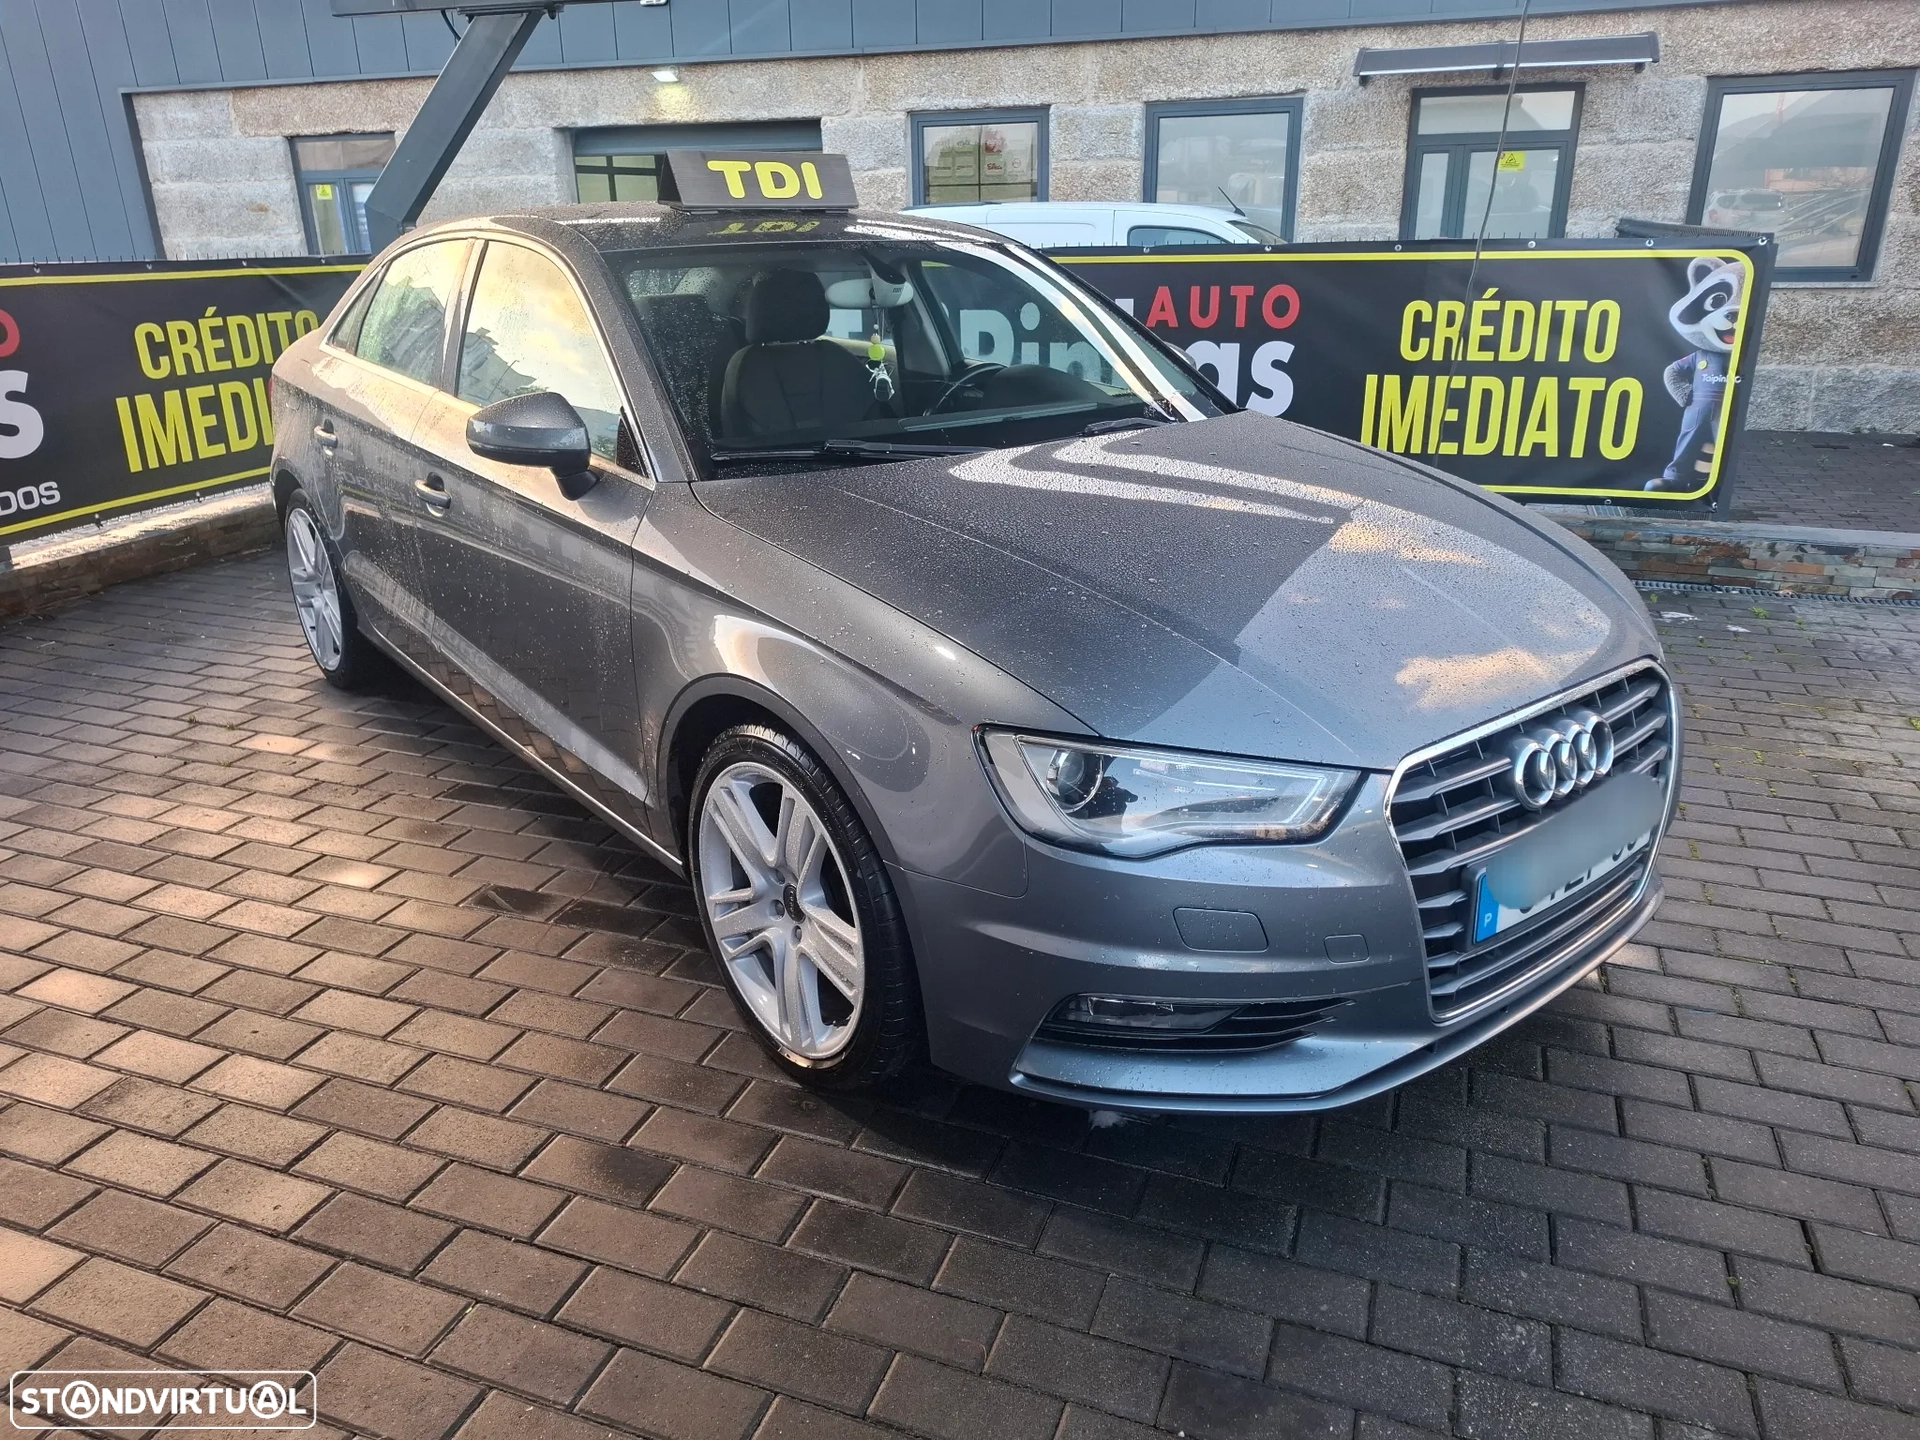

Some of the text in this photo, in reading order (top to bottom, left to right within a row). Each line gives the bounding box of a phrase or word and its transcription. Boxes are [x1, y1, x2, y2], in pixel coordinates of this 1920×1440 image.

[707, 161, 823, 199] TDI
[1145, 284, 1300, 329] AUTO
[1400, 287, 1621, 363] CRÉDITO
[1702, 373, 1728, 384] Taipin
[116, 377, 274, 473] IMEDI
[1360, 374, 1644, 460] IMEDIATO
[0, 481, 61, 516] DOS
[1484, 913, 1492, 927] P
